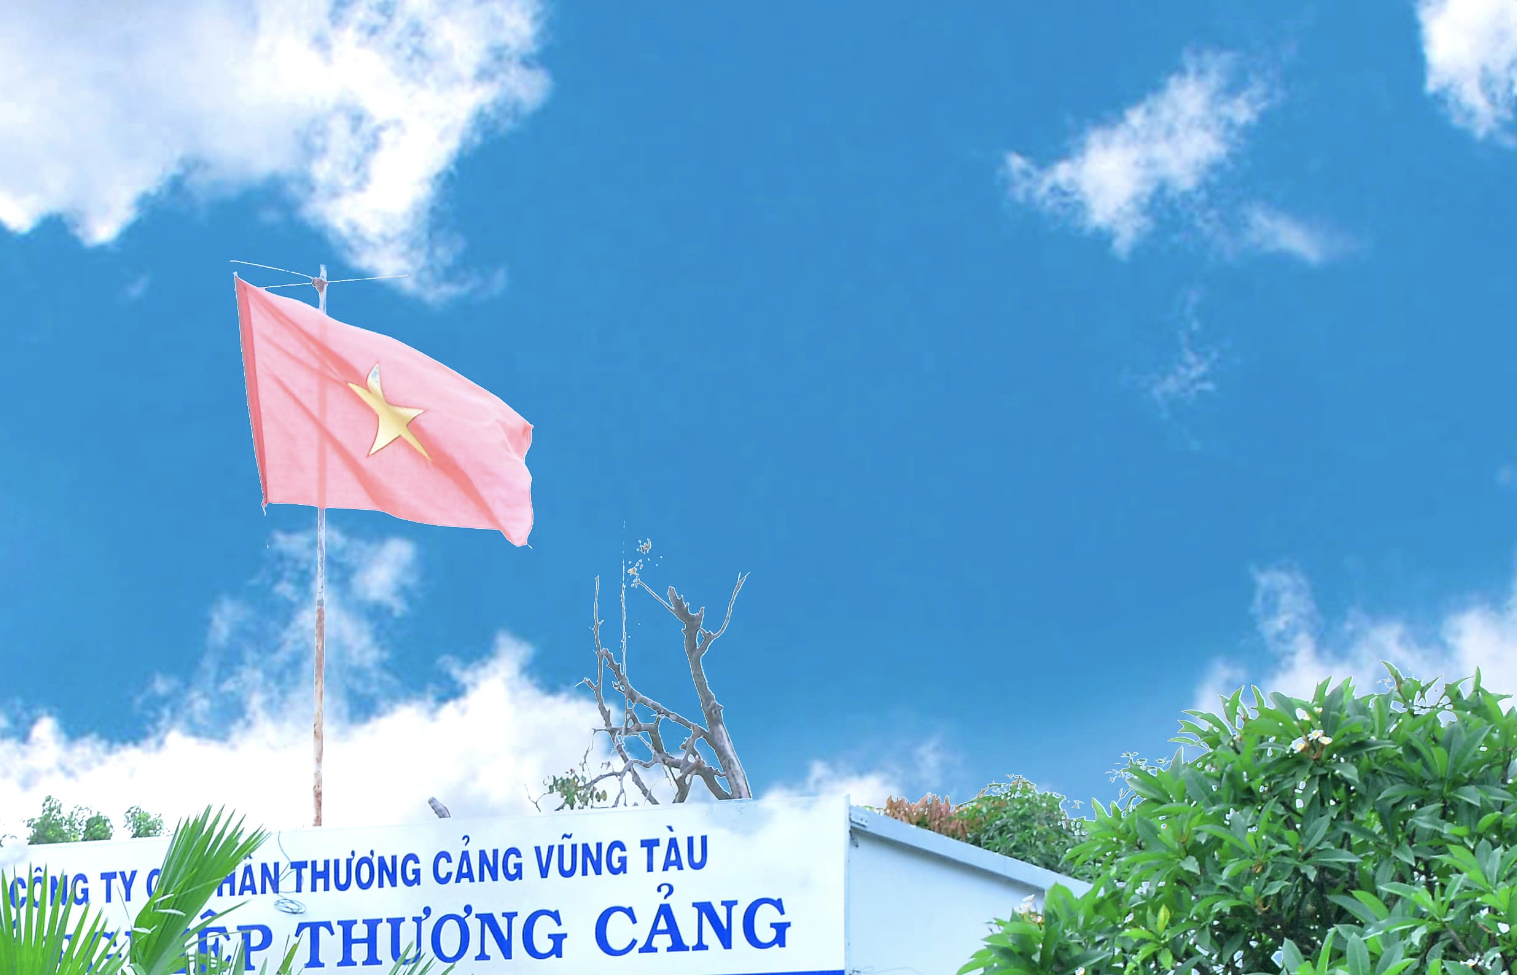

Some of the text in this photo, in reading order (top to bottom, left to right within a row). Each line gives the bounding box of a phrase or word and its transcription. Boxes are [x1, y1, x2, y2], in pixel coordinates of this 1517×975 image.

[100, 870, 138, 903] TY
[290, 850, 421, 893] THƯƠNG
[432, 835, 523, 885] CẢNG
[534, 833, 628, 878] VŨNG
[640, 826, 708, 873] TÀU
[295, 904, 568, 968] THƯƠNG
[595, 883, 792, 957] CẢNG
